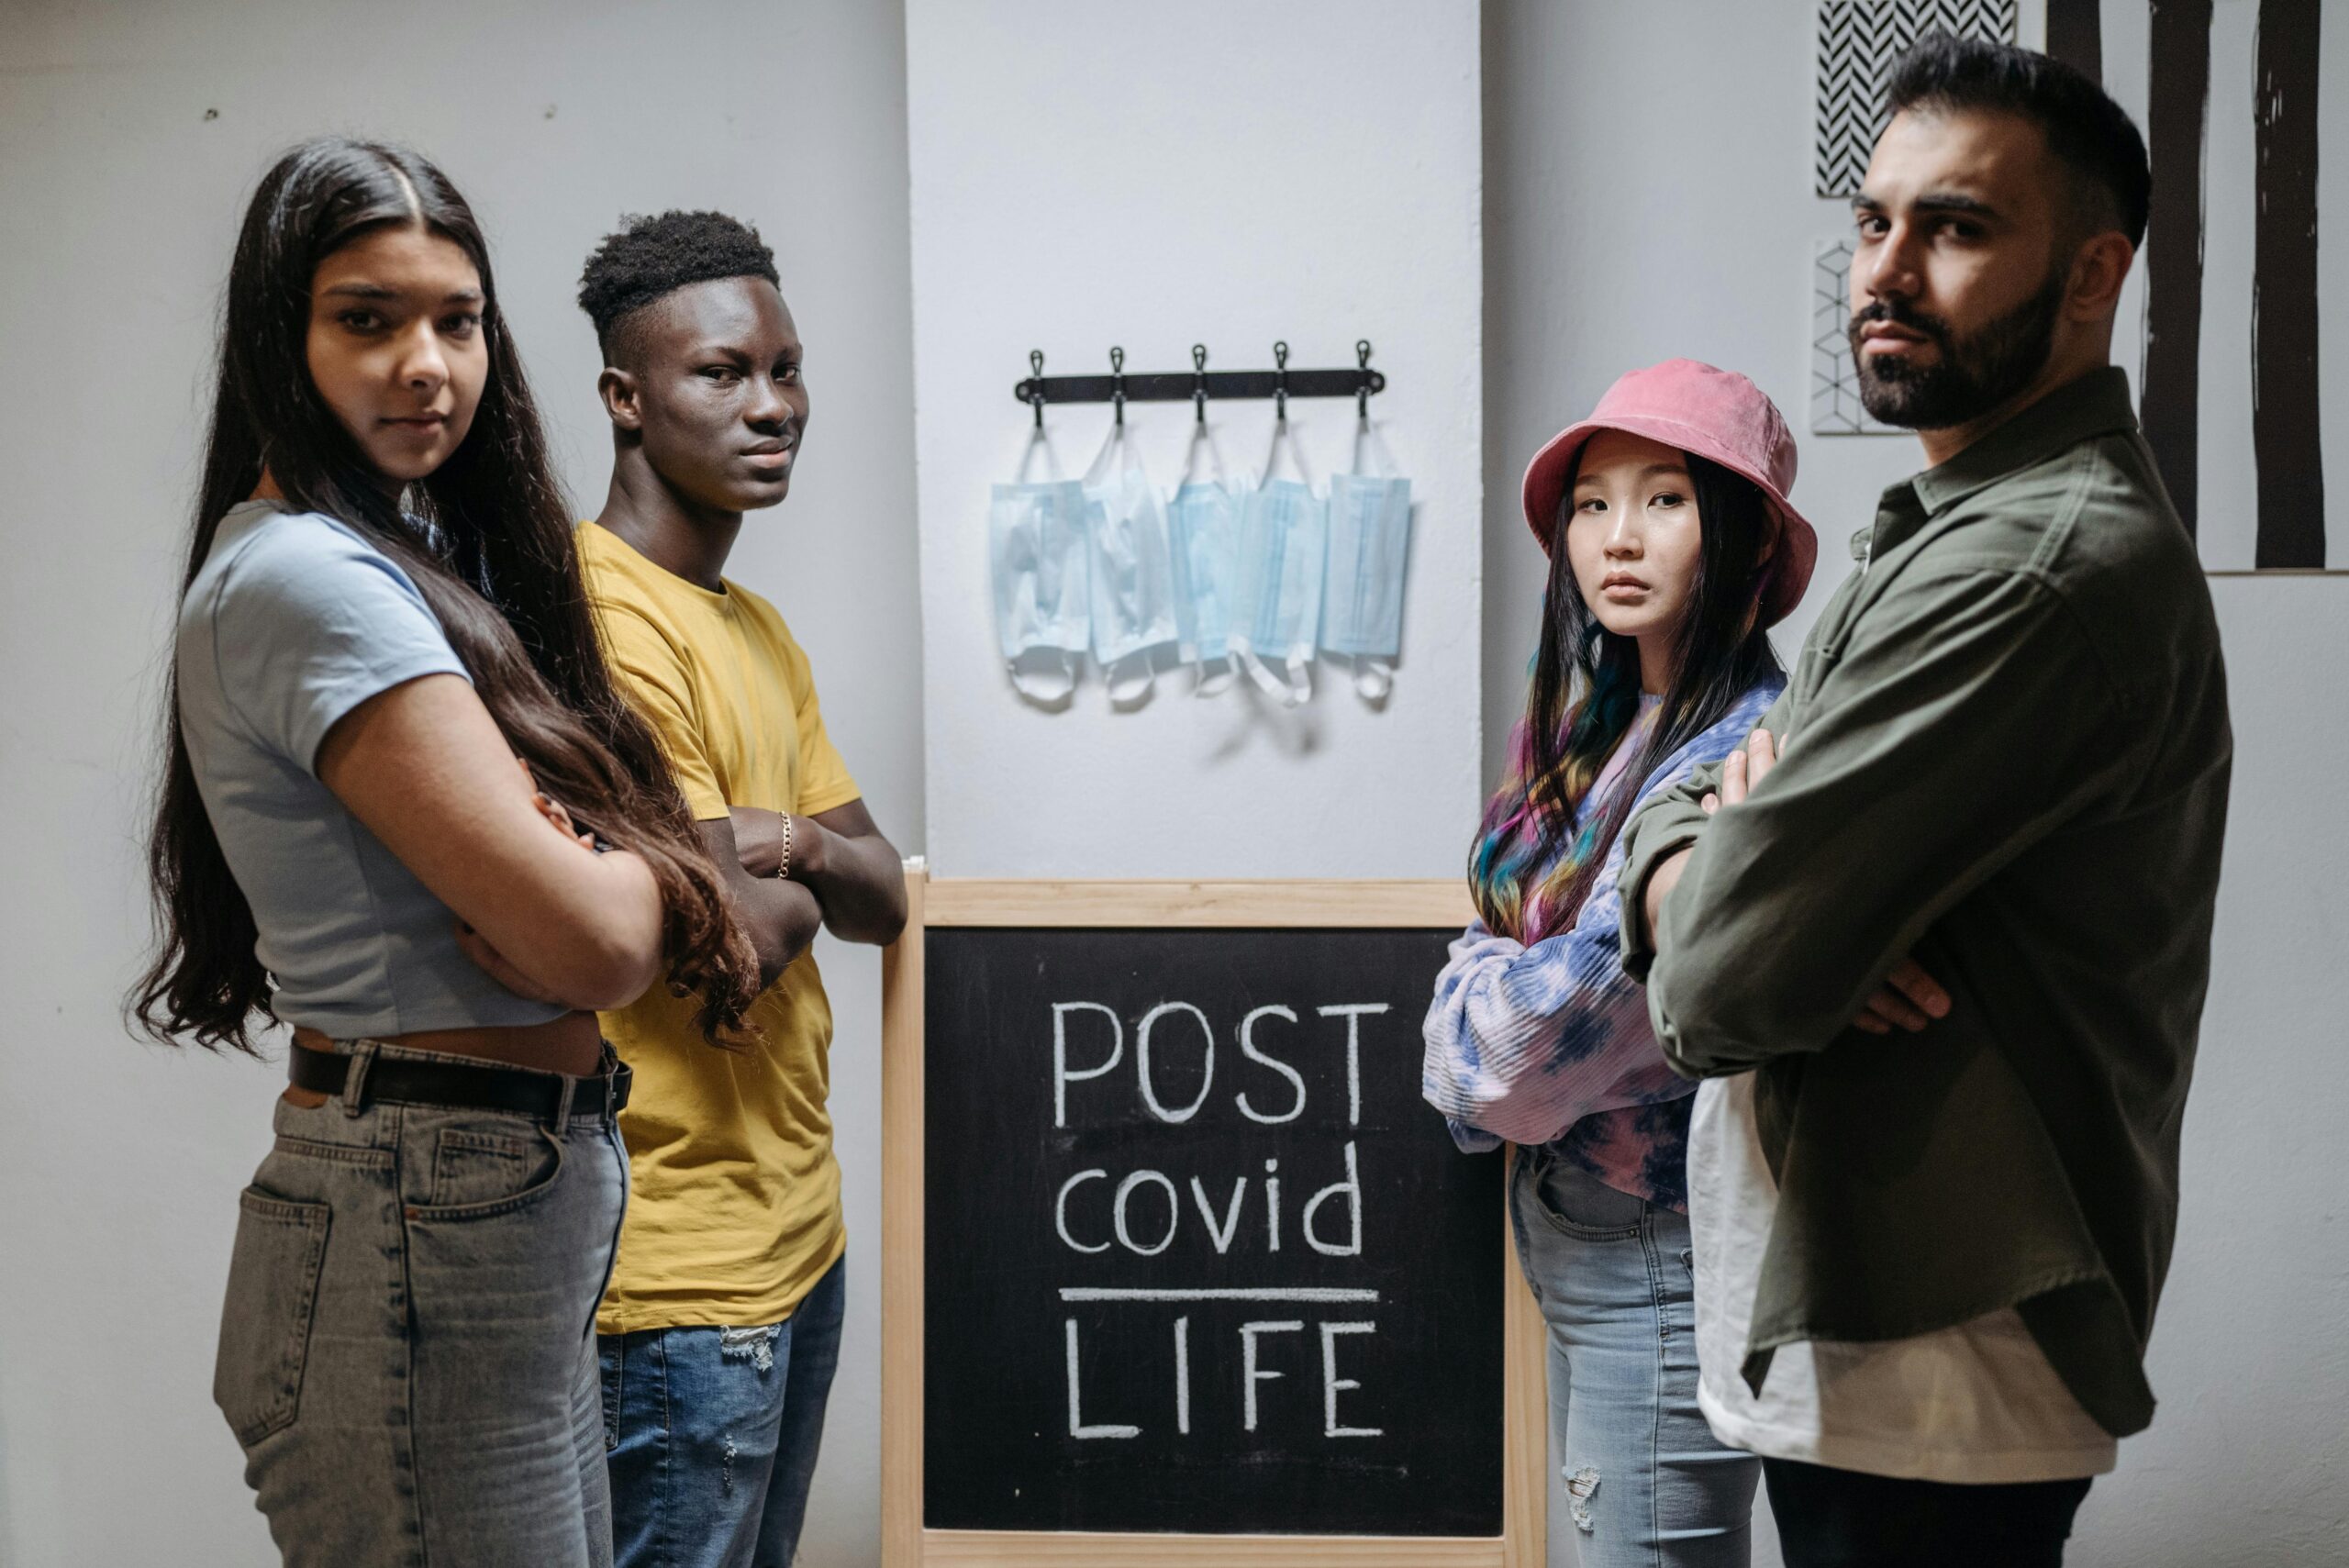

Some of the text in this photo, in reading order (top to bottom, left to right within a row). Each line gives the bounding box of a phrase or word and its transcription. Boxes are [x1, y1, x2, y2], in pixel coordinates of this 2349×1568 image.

[1051, 1001, 1391, 1129] POST
[1055, 1140, 1363, 1256] covid
[1065, 1316, 1384, 1440] LIFE
